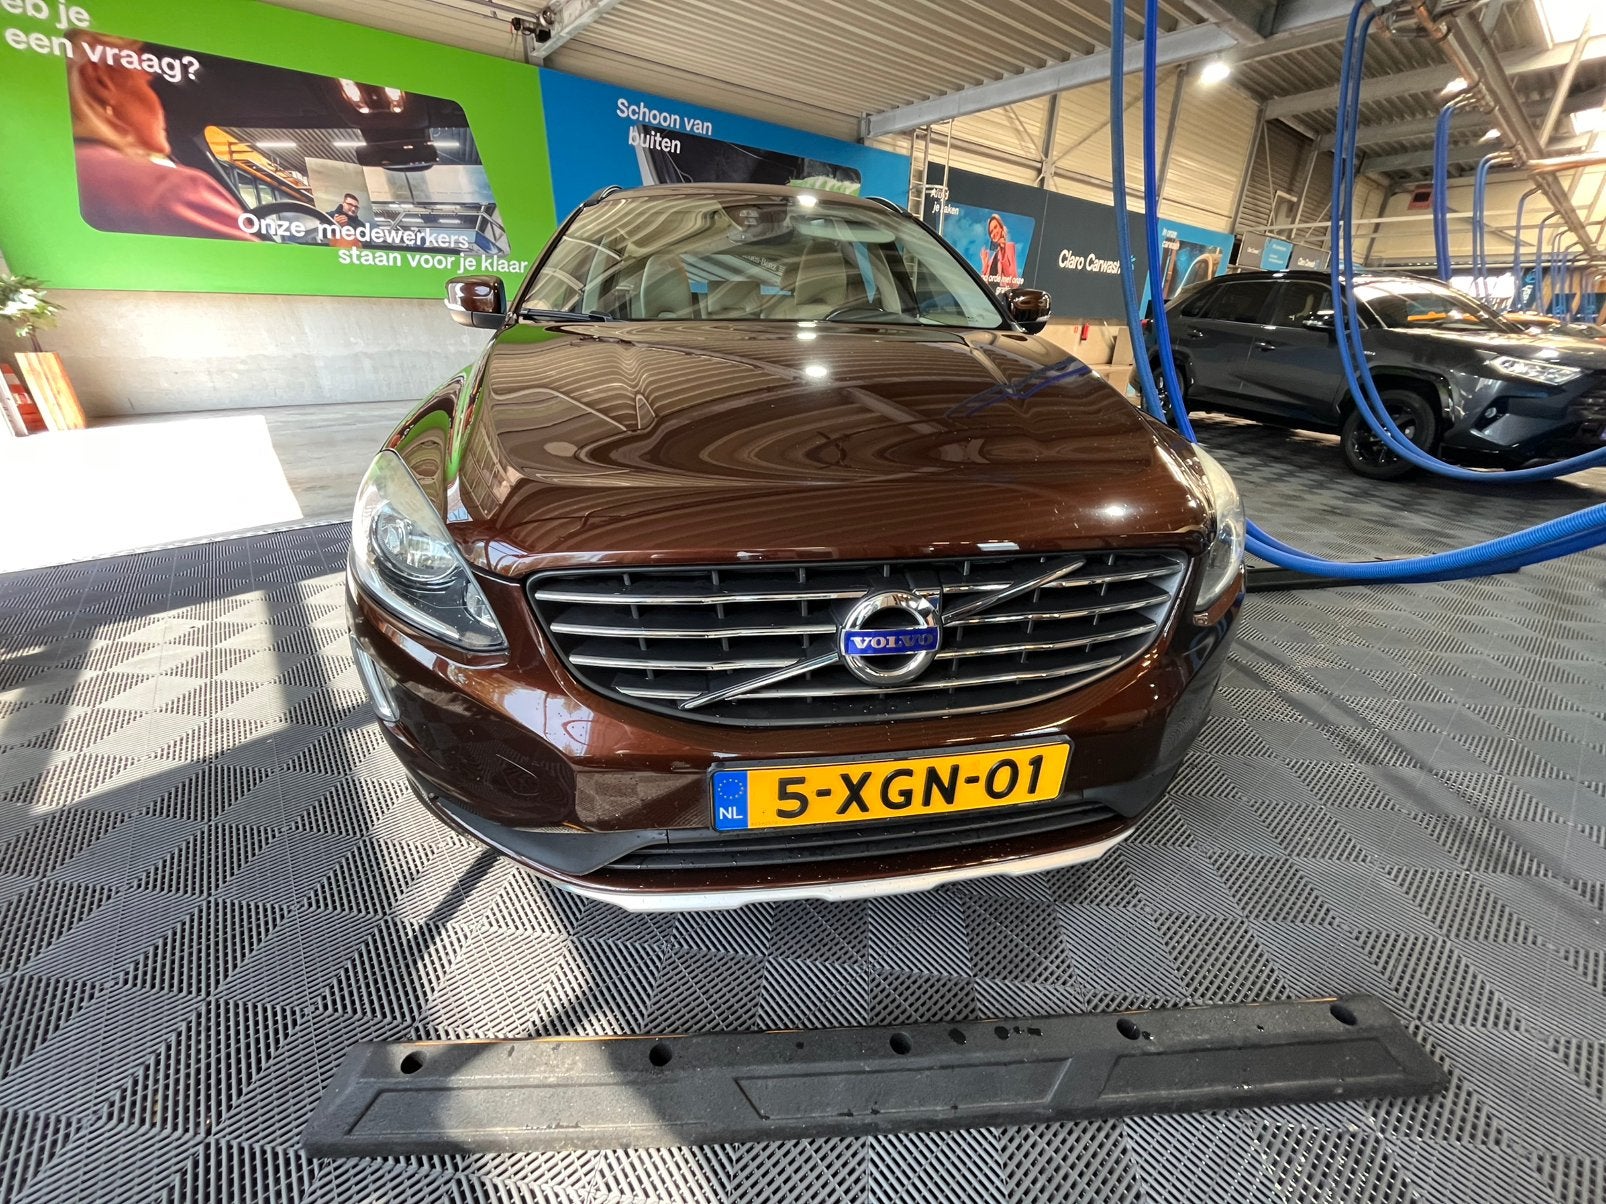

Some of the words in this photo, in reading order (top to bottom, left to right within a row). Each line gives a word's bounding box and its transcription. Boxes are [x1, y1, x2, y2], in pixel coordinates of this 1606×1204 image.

[55, 0, 90, 29] je
[4, 28, 74, 58] een
[81, 41, 200, 83] vraag?
[617, 98, 680, 129] Schoon
[684, 117, 713, 136] van
[628, 126, 681, 154] buiten
[931, 201, 940, 214] je
[942, 203, 960, 216] aken
[237, 213, 306, 237] Onze
[317, 221, 469, 249] medewerkers
[338, 246, 402, 267] staan
[407, 252, 455, 270] voor
[456, 253, 477, 274] je
[481, 254, 528, 274] klaar
[1058, 249, 1085, 270] Claro
[850, 633, 934, 650] VOLVO
[775, 754, 1044, 820] 5-XGN-01
[718, 806, 744, 821] NL
